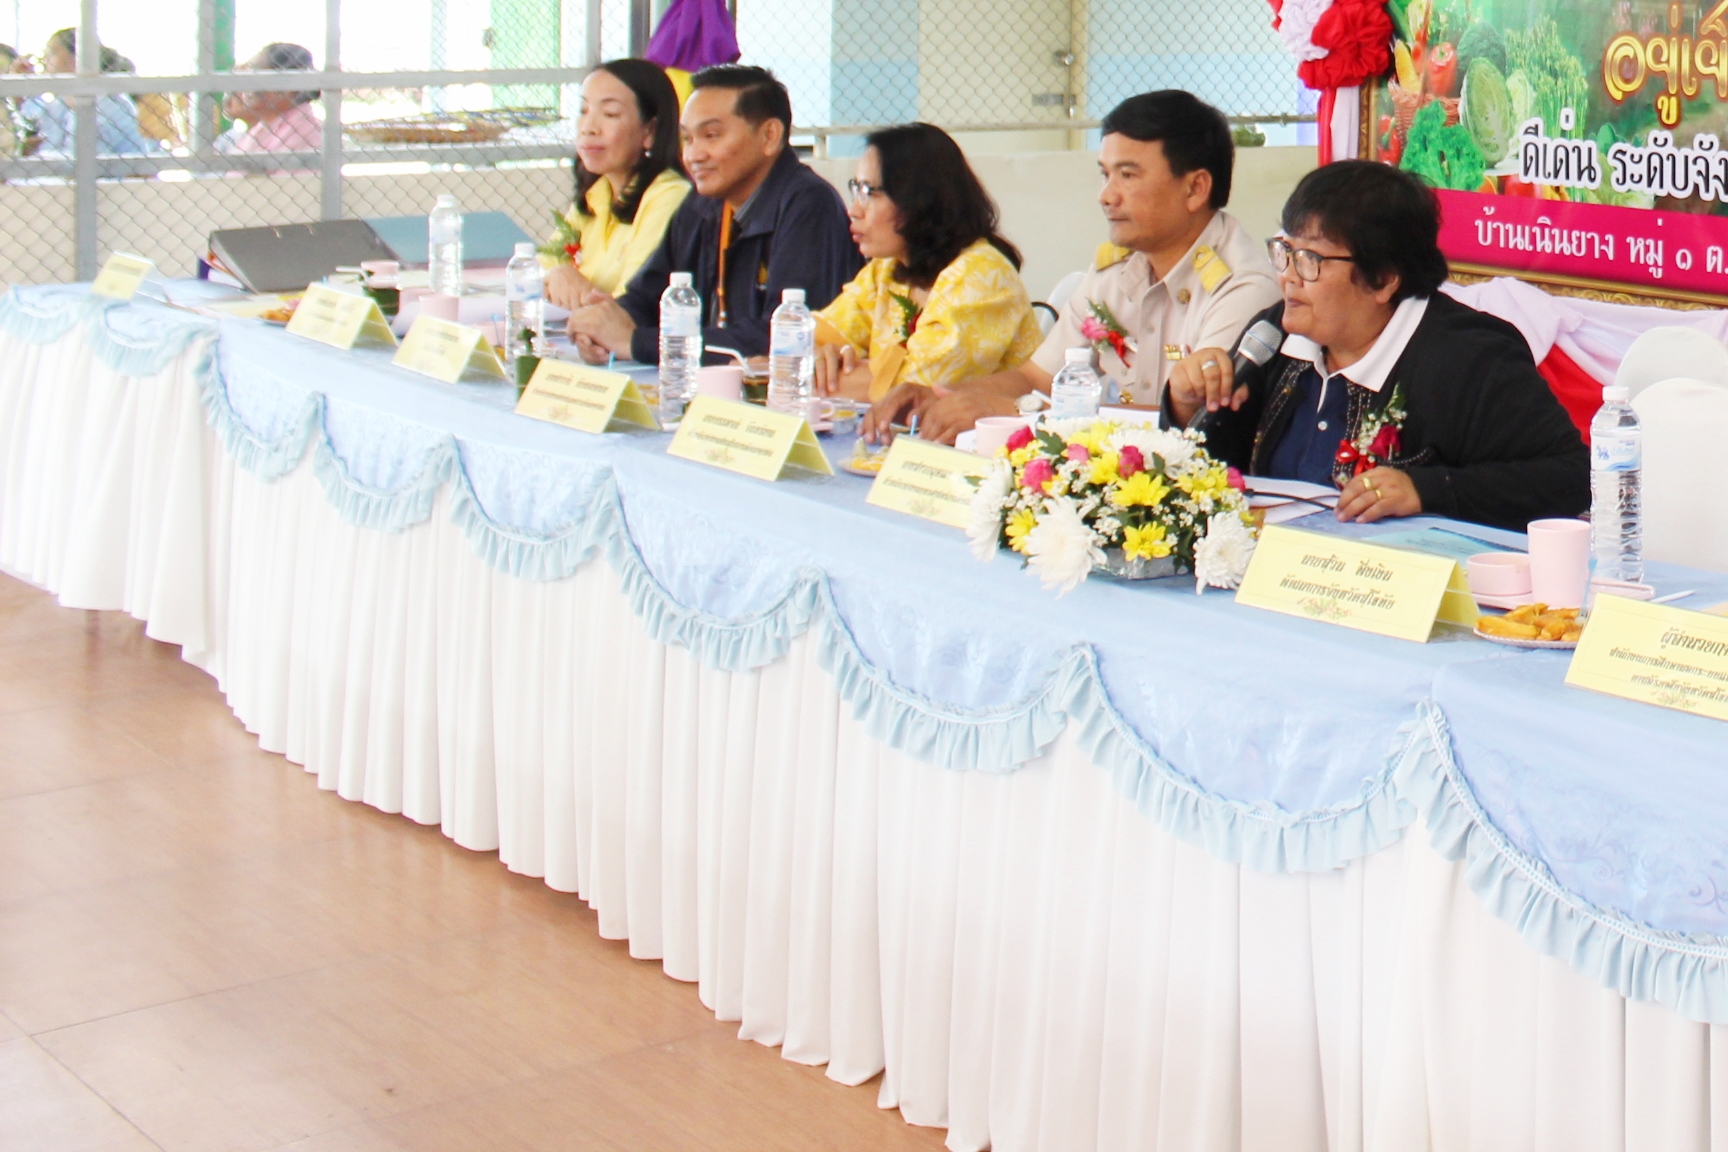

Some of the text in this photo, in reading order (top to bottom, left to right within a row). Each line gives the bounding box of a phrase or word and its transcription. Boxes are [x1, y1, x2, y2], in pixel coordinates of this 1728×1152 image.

[1519, 108, 1598, 189] ดีเด่น
[1474, 206, 1614, 262] บ้านเนินยาง
[1625, 212, 1664, 279] หมู่
[1674, 247, 1693, 272] ๑
